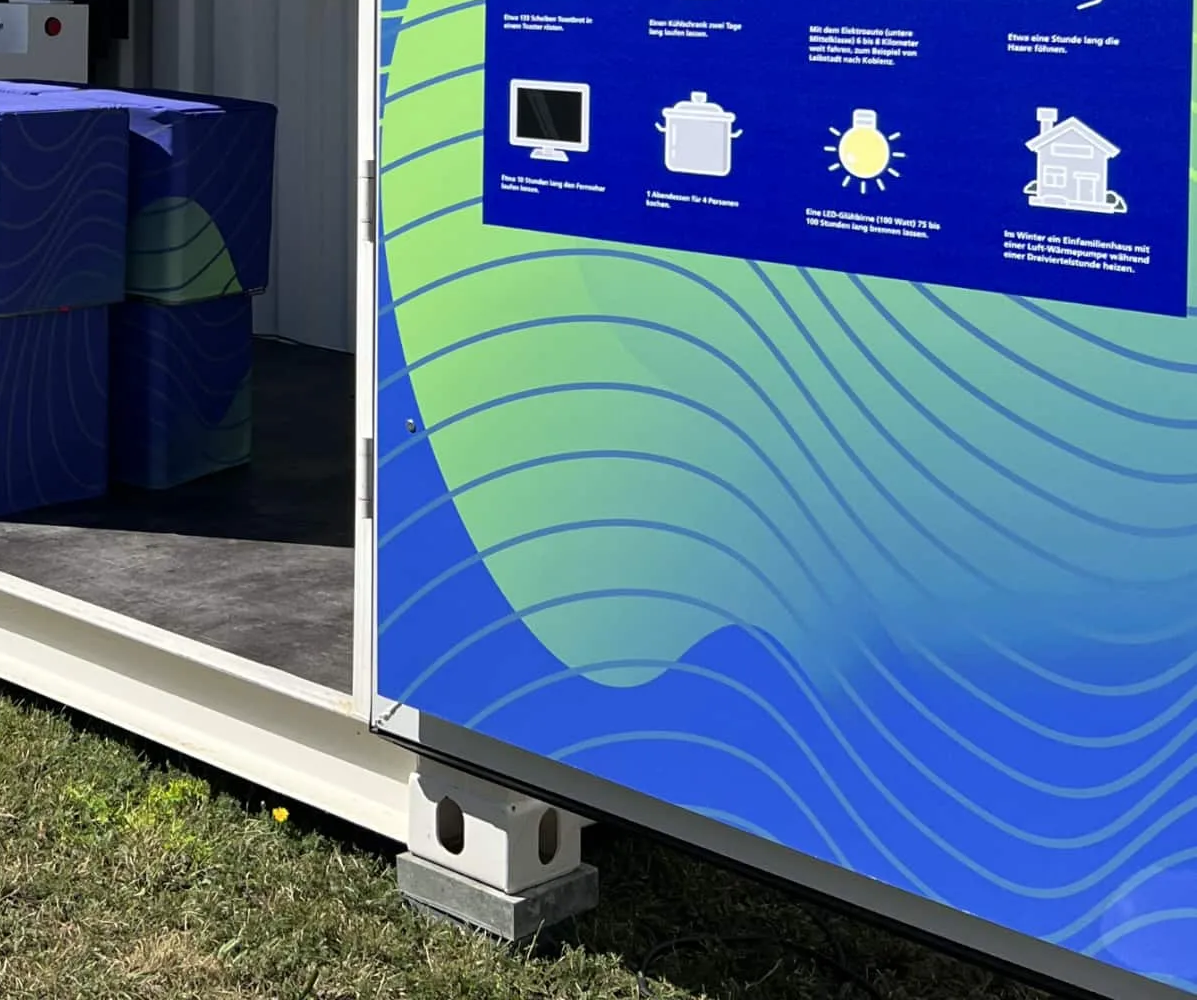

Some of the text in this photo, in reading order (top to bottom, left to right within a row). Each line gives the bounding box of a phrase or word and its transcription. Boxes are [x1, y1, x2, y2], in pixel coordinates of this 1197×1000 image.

[1008, 33, 1119, 47] Etwa eine Stunde lang die
[1004, 230, 1149, 254] Im Winter ein Einfamilienhaus mit
[1004, 240, 1149, 265] einer Luft-Wärmepumpe während
[1004, 251, 1134, 273] einer Dreiviertelstunde heizen.
